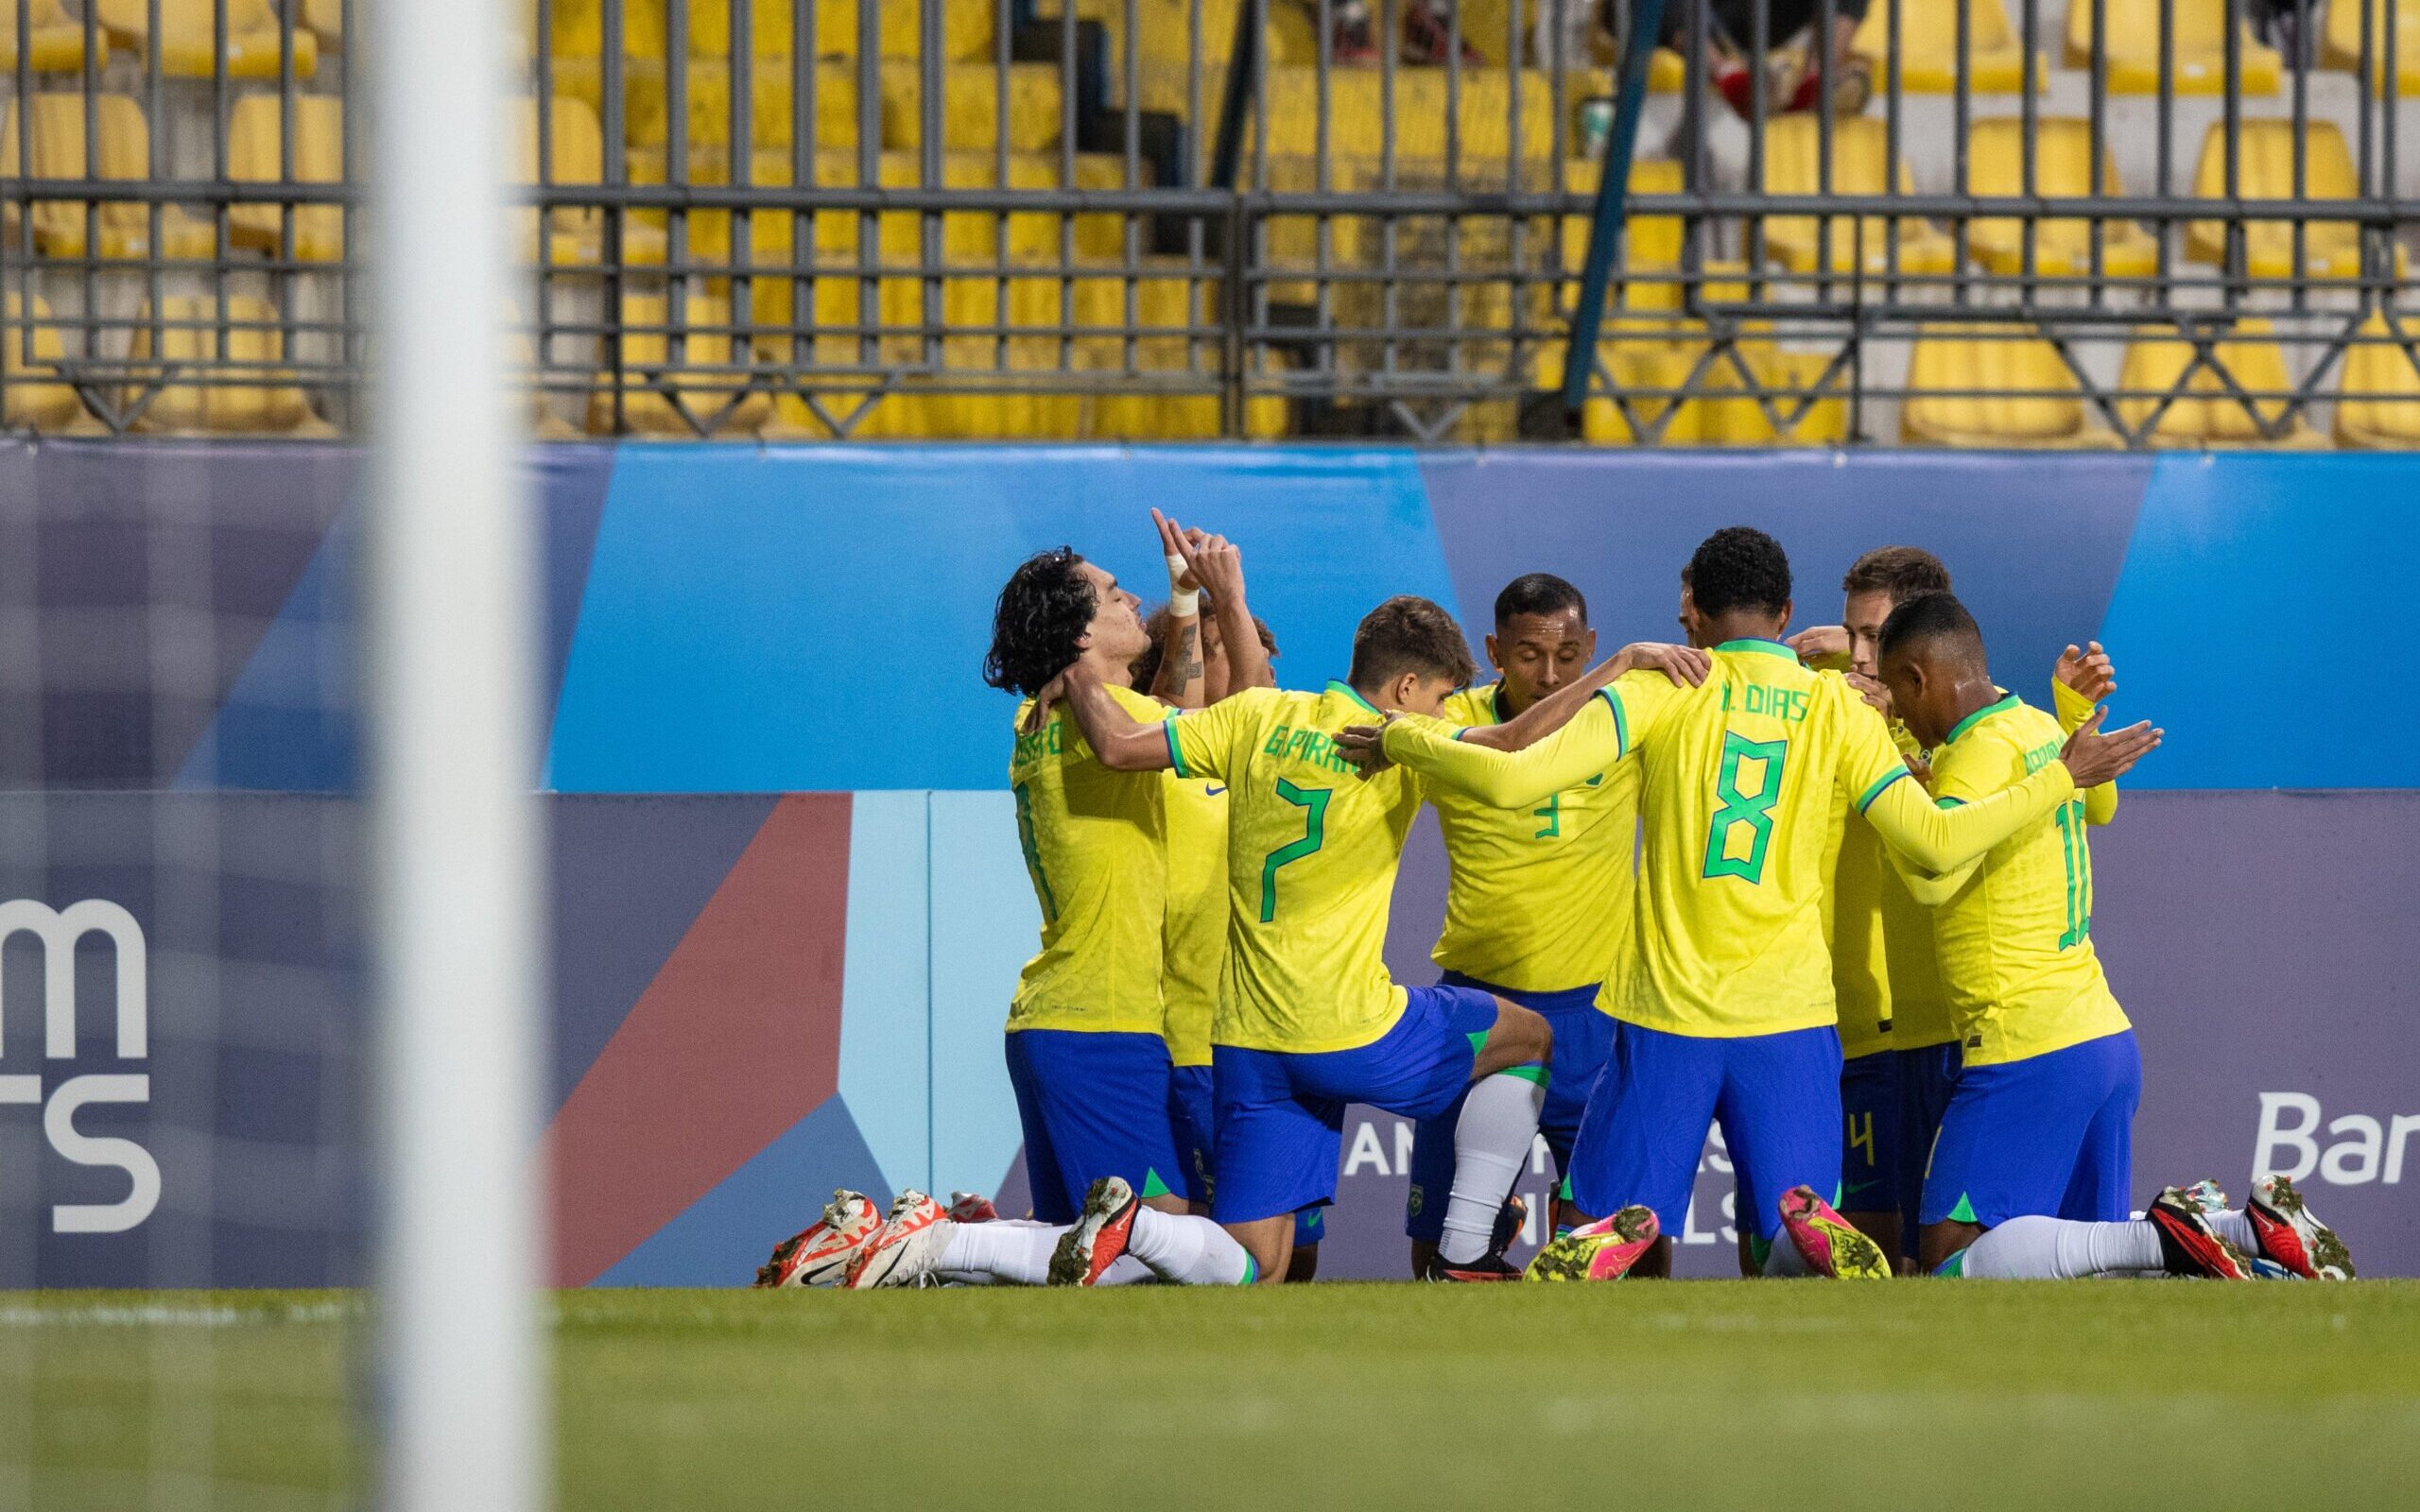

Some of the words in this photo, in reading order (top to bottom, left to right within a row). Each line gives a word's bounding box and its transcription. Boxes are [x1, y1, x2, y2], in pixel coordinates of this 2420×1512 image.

[1745, 684, 1810, 722] DIAS
[1260, 777, 1332, 923] 7
[1703, 730, 1789, 885] 8
[1849, 1111, 1875, 1166] 4
